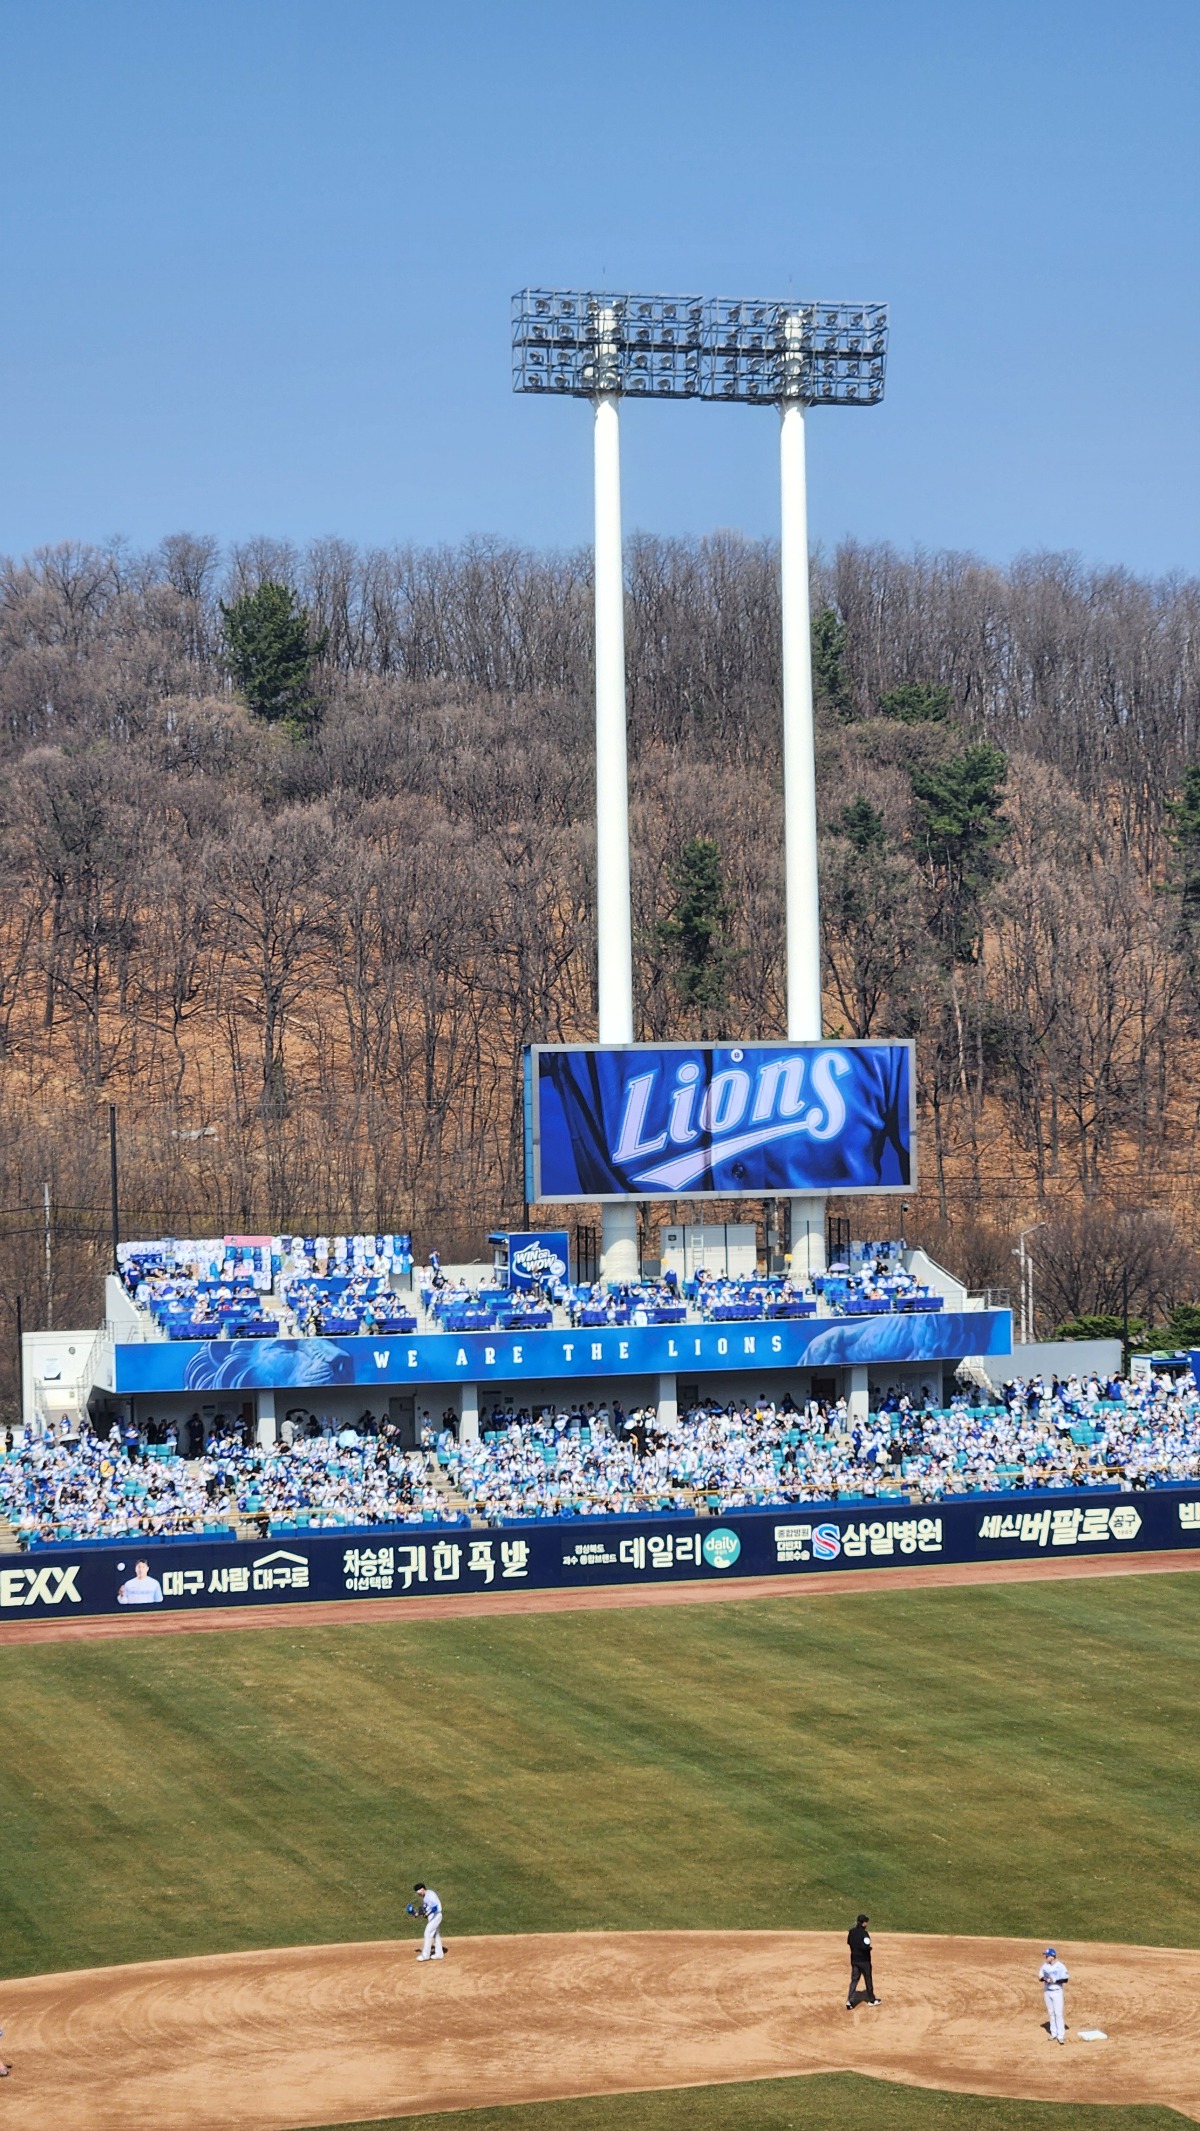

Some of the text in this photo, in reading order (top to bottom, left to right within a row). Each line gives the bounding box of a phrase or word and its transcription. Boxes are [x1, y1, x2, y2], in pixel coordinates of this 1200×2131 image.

[611, 1050, 851, 1164] Lions
[516, 1249, 539, 1264] WIN
[526, 1256, 555, 1272] WOW
[373, 1335, 782, 1369] WE ARE THE LIONS
[1114, 1514, 1136, 1528] 공구
[619, 1533, 702, 1570] 데일리
[705, 1536, 738, 1553] daily
[841, 1518, 943, 1557] 삼일병원
[343, 1547, 395, 1577] 차승원
[162, 1566, 310, 1596] 대구 사람 대구로
